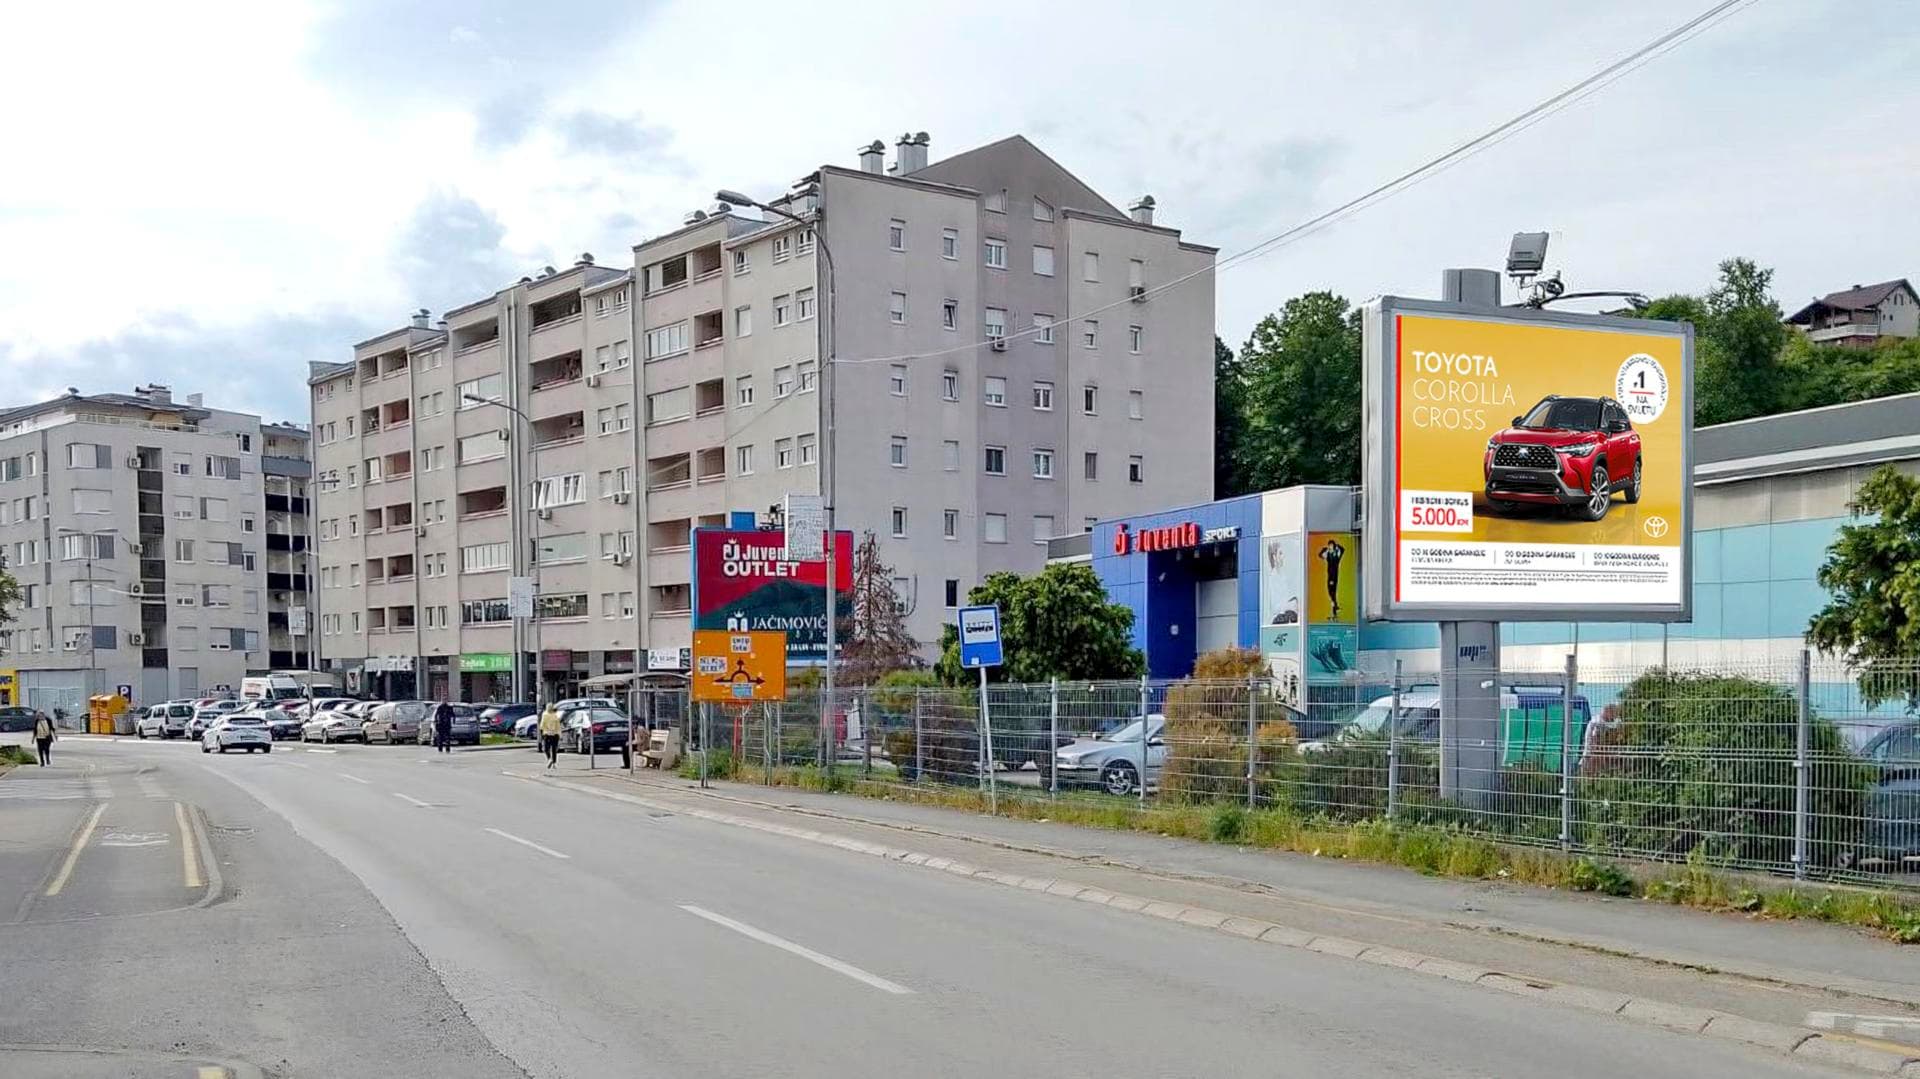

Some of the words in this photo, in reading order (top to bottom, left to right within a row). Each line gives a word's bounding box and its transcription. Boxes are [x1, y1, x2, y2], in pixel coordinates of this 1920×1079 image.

[1412, 350, 1498, 377] TOYOTA
[1413, 378, 1516, 407] COROLLA
[1413, 406, 1487, 431] CROSS
[1412, 507, 1456, 526] 5.000
[1204, 526, 1239, 542] SPORT
[742, 544, 785, 561] Juven
[723, 561, 800, 577] OUTLET
[751, 614, 828, 630] JAČIMOVIĆ
